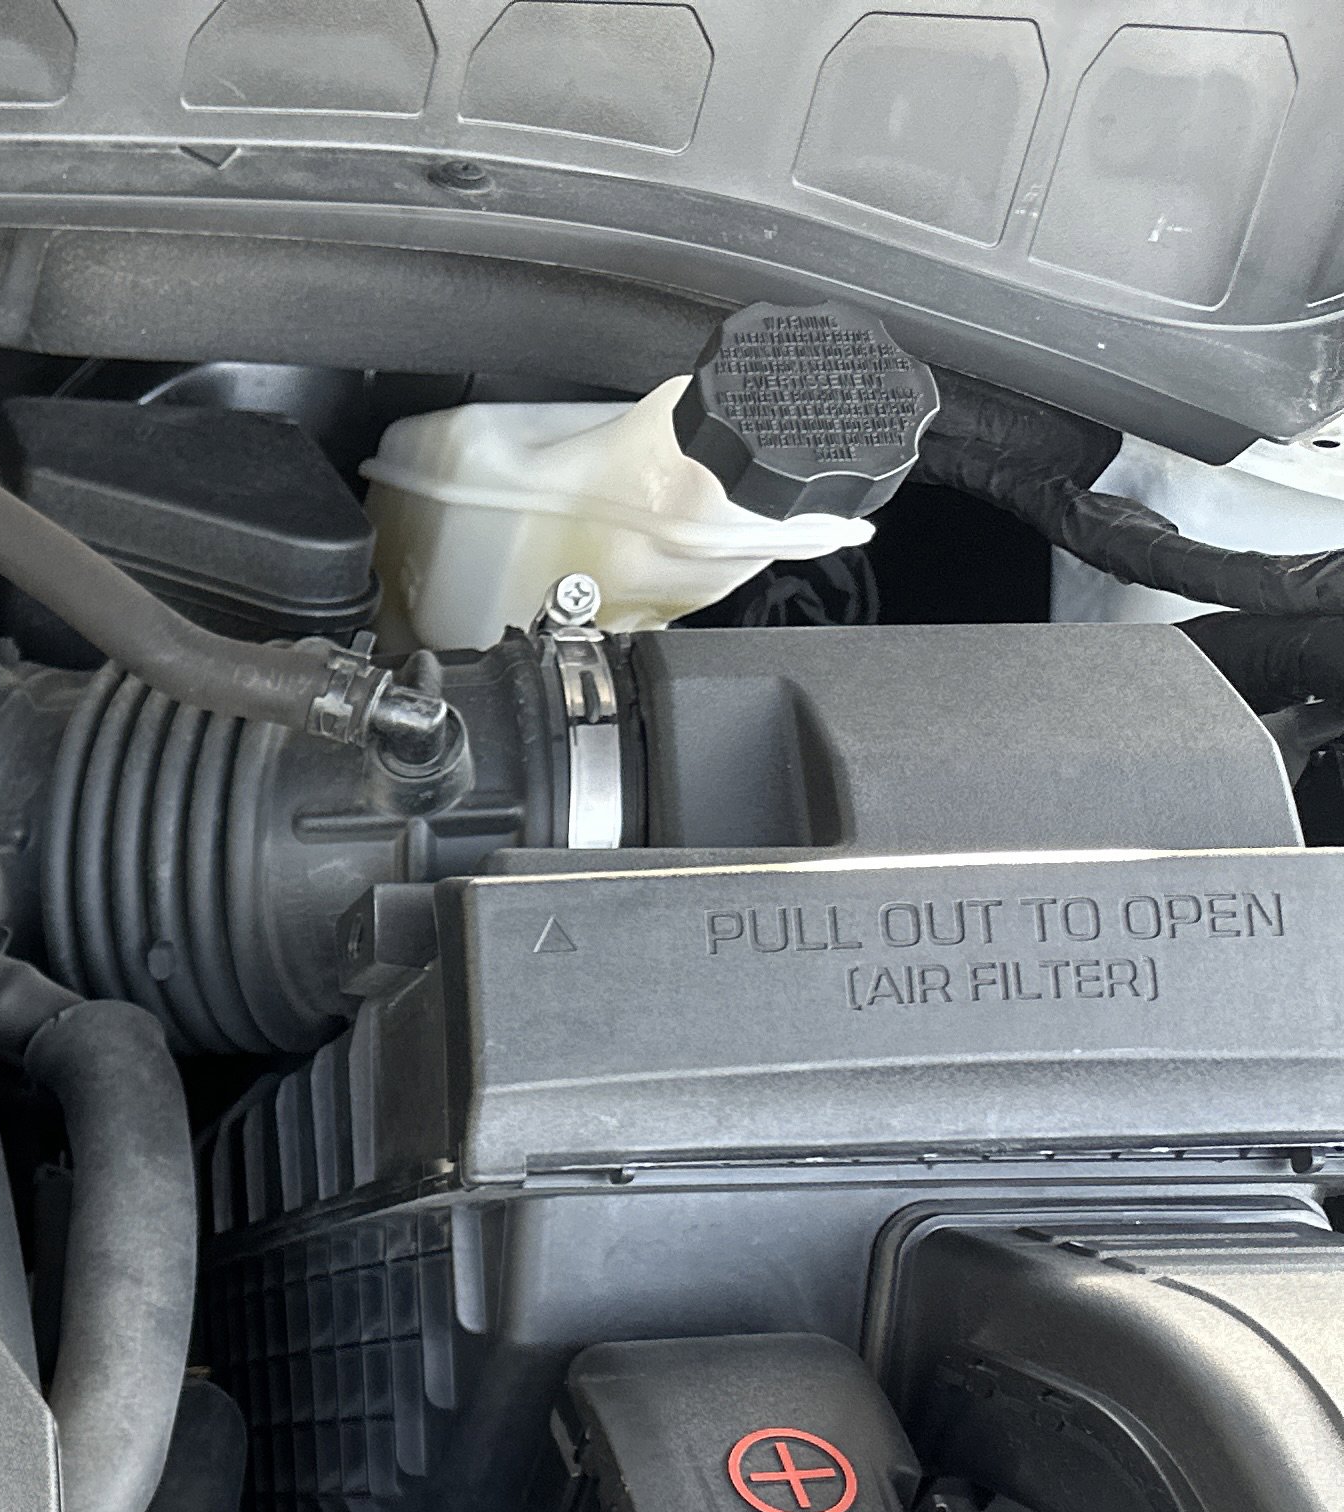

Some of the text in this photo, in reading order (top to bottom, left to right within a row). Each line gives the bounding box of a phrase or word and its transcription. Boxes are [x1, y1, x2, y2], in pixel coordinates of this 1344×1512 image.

[705, 891, 1287, 956] PULL OUT TO OPEN
